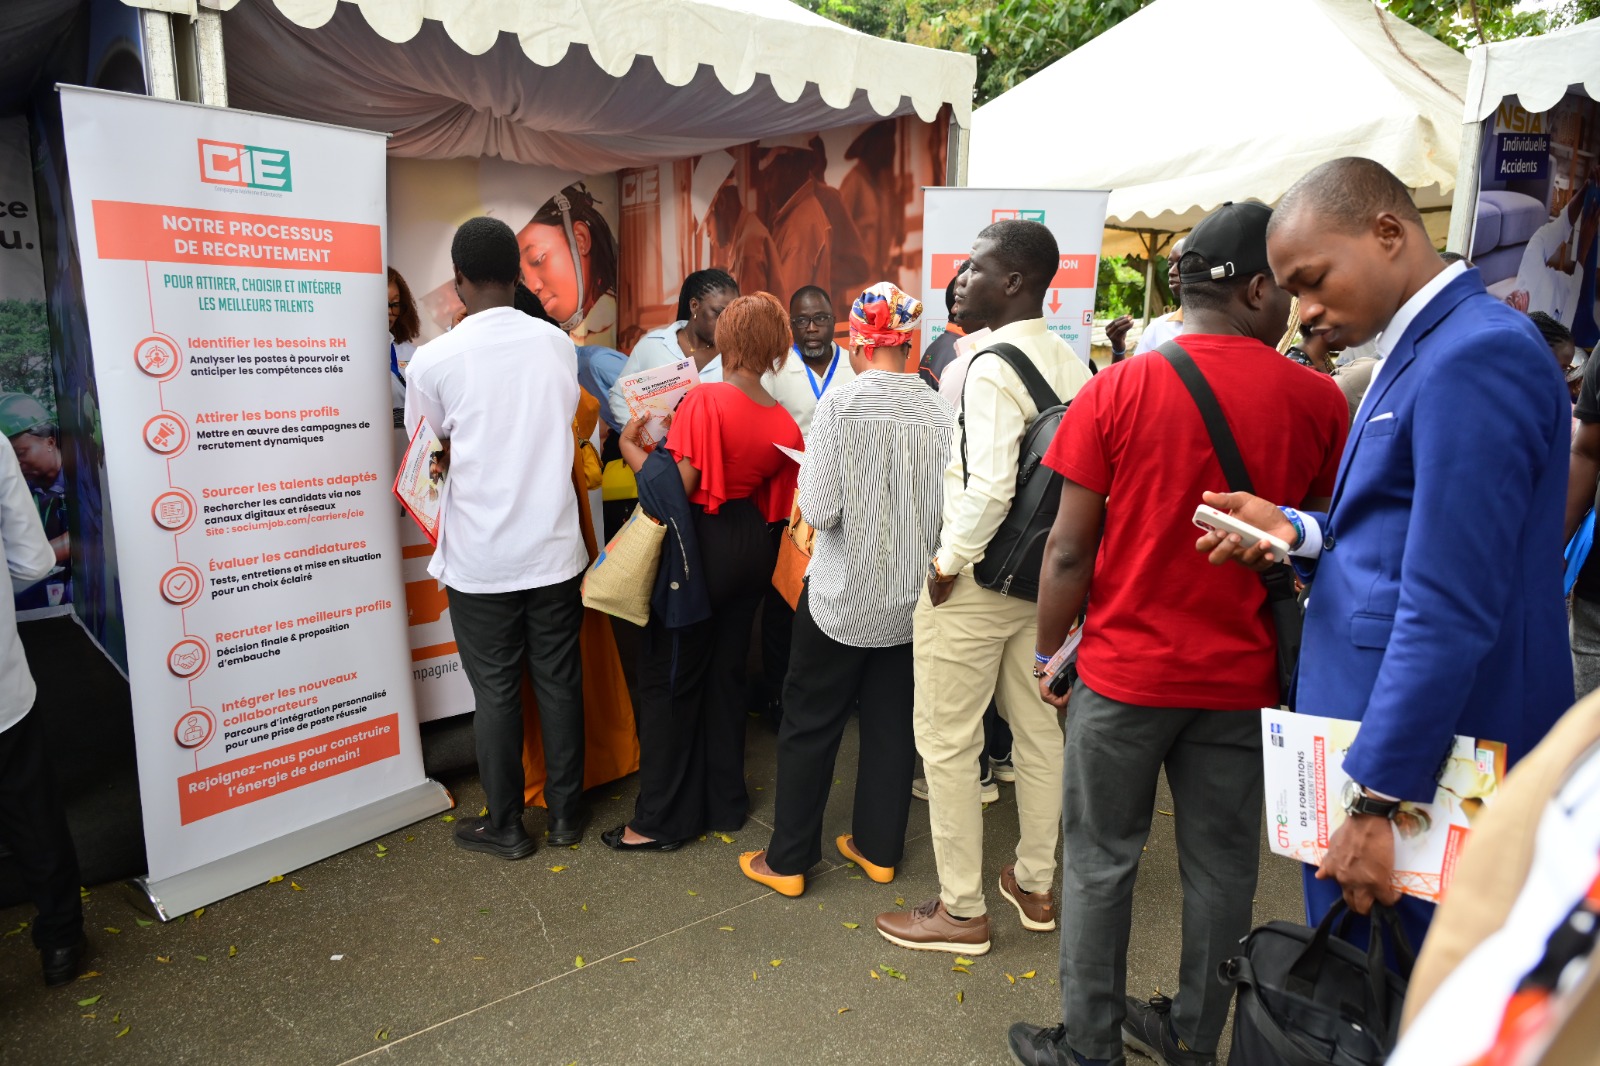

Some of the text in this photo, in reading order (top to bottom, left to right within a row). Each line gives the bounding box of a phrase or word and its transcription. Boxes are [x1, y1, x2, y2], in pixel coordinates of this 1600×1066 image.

[1496, 102, 1542, 133] NSIA
[1502, 137, 1547, 152] Individuelle
[201, 141, 288, 189] CIE
[1500, 158, 1538, 173] Accidents
[621, 169, 658, 206] CIE
[0, 231, 34, 249] u.
[162, 215, 334, 243] NOTRE PROCESSUS
[174, 239, 331, 263] DE RECRUTEMENT
[1060, 260, 1078, 269] ION
[164, 274, 341, 294] POUR ATTIRER, CHOISIR ET INTÉGRER
[199, 297, 313, 312] LES MEILLEURS TALENTS
[1086, 314, 1091, 322] 2
[188, 337, 346, 348] Identifier les besoins RH
[190, 355, 235, 366] Analyser
[237, 355, 252, 363] les
[254, 355, 287, 365] postes
[290, 354, 296, 362] à
[298, 354, 338, 364] pourvoir
[191, 366, 236, 378] anticiper
[256, 366, 322, 376] compétences
[324, 365, 343, 373] clés
[196, 406, 339, 423] Attirer les bons profils
[197, 430, 230, 439] Mettre
[282, 425, 298, 433] des
[301, 423, 357, 433] campagnes
[198, 435, 324, 450] recrutement dynamiques
[203, 472, 377, 498] Sourcer les talents adaptés
[204, 501, 260, 513] Rechercher
[279, 493, 326, 504] candidats
[328, 490, 342, 498] via
[205, 514, 242, 525] canaux
[244, 509, 285, 521] digitaux
[299, 503, 336, 513] réseaux
[206, 528, 224, 536] Site
[209, 541, 366, 571] Évaluer les candidatures
[210, 576, 239, 586] Tests,
[242, 567, 292, 580] entretiens
[294, 564, 302, 572] et
[305, 561, 326, 570] mise
[342, 553, 381, 564] situation
[212, 588, 234, 600] pour
[252, 579, 278, 590] choix
[281, 572, 312, 585] éclairé
[216, 600, 391, 642] Recruter les meilleurs profils
[217, 643, 258, 657] Décision
[261, 636, 288, 647] finale
[299, 624, 349, 642] proposition
[218, 649, 280, 668] d'embauche
[222, 672, 357, 712] Intégrer les nouveaux
[224, 696, 318, 726] collaborateurs
[224, 690, 386, 740] Parcours d'intégration personnalisé
[226, 739, 248, 753] pour
[251, 734, 269, 743] une
[271, 727, 295, 740] prise
[310, 716, 334, 729] poste
[336, 706, 367, 719] réussie
[190, 726, 390, 793] Rejoignez-nous pour construire
[229, 748, 359, 796] l'énergie de demain!
[1297, 751, 1306, 808] FORMATIONS
[1314, 740, 1327, 846] AVENIR PROFESSIONNEL
